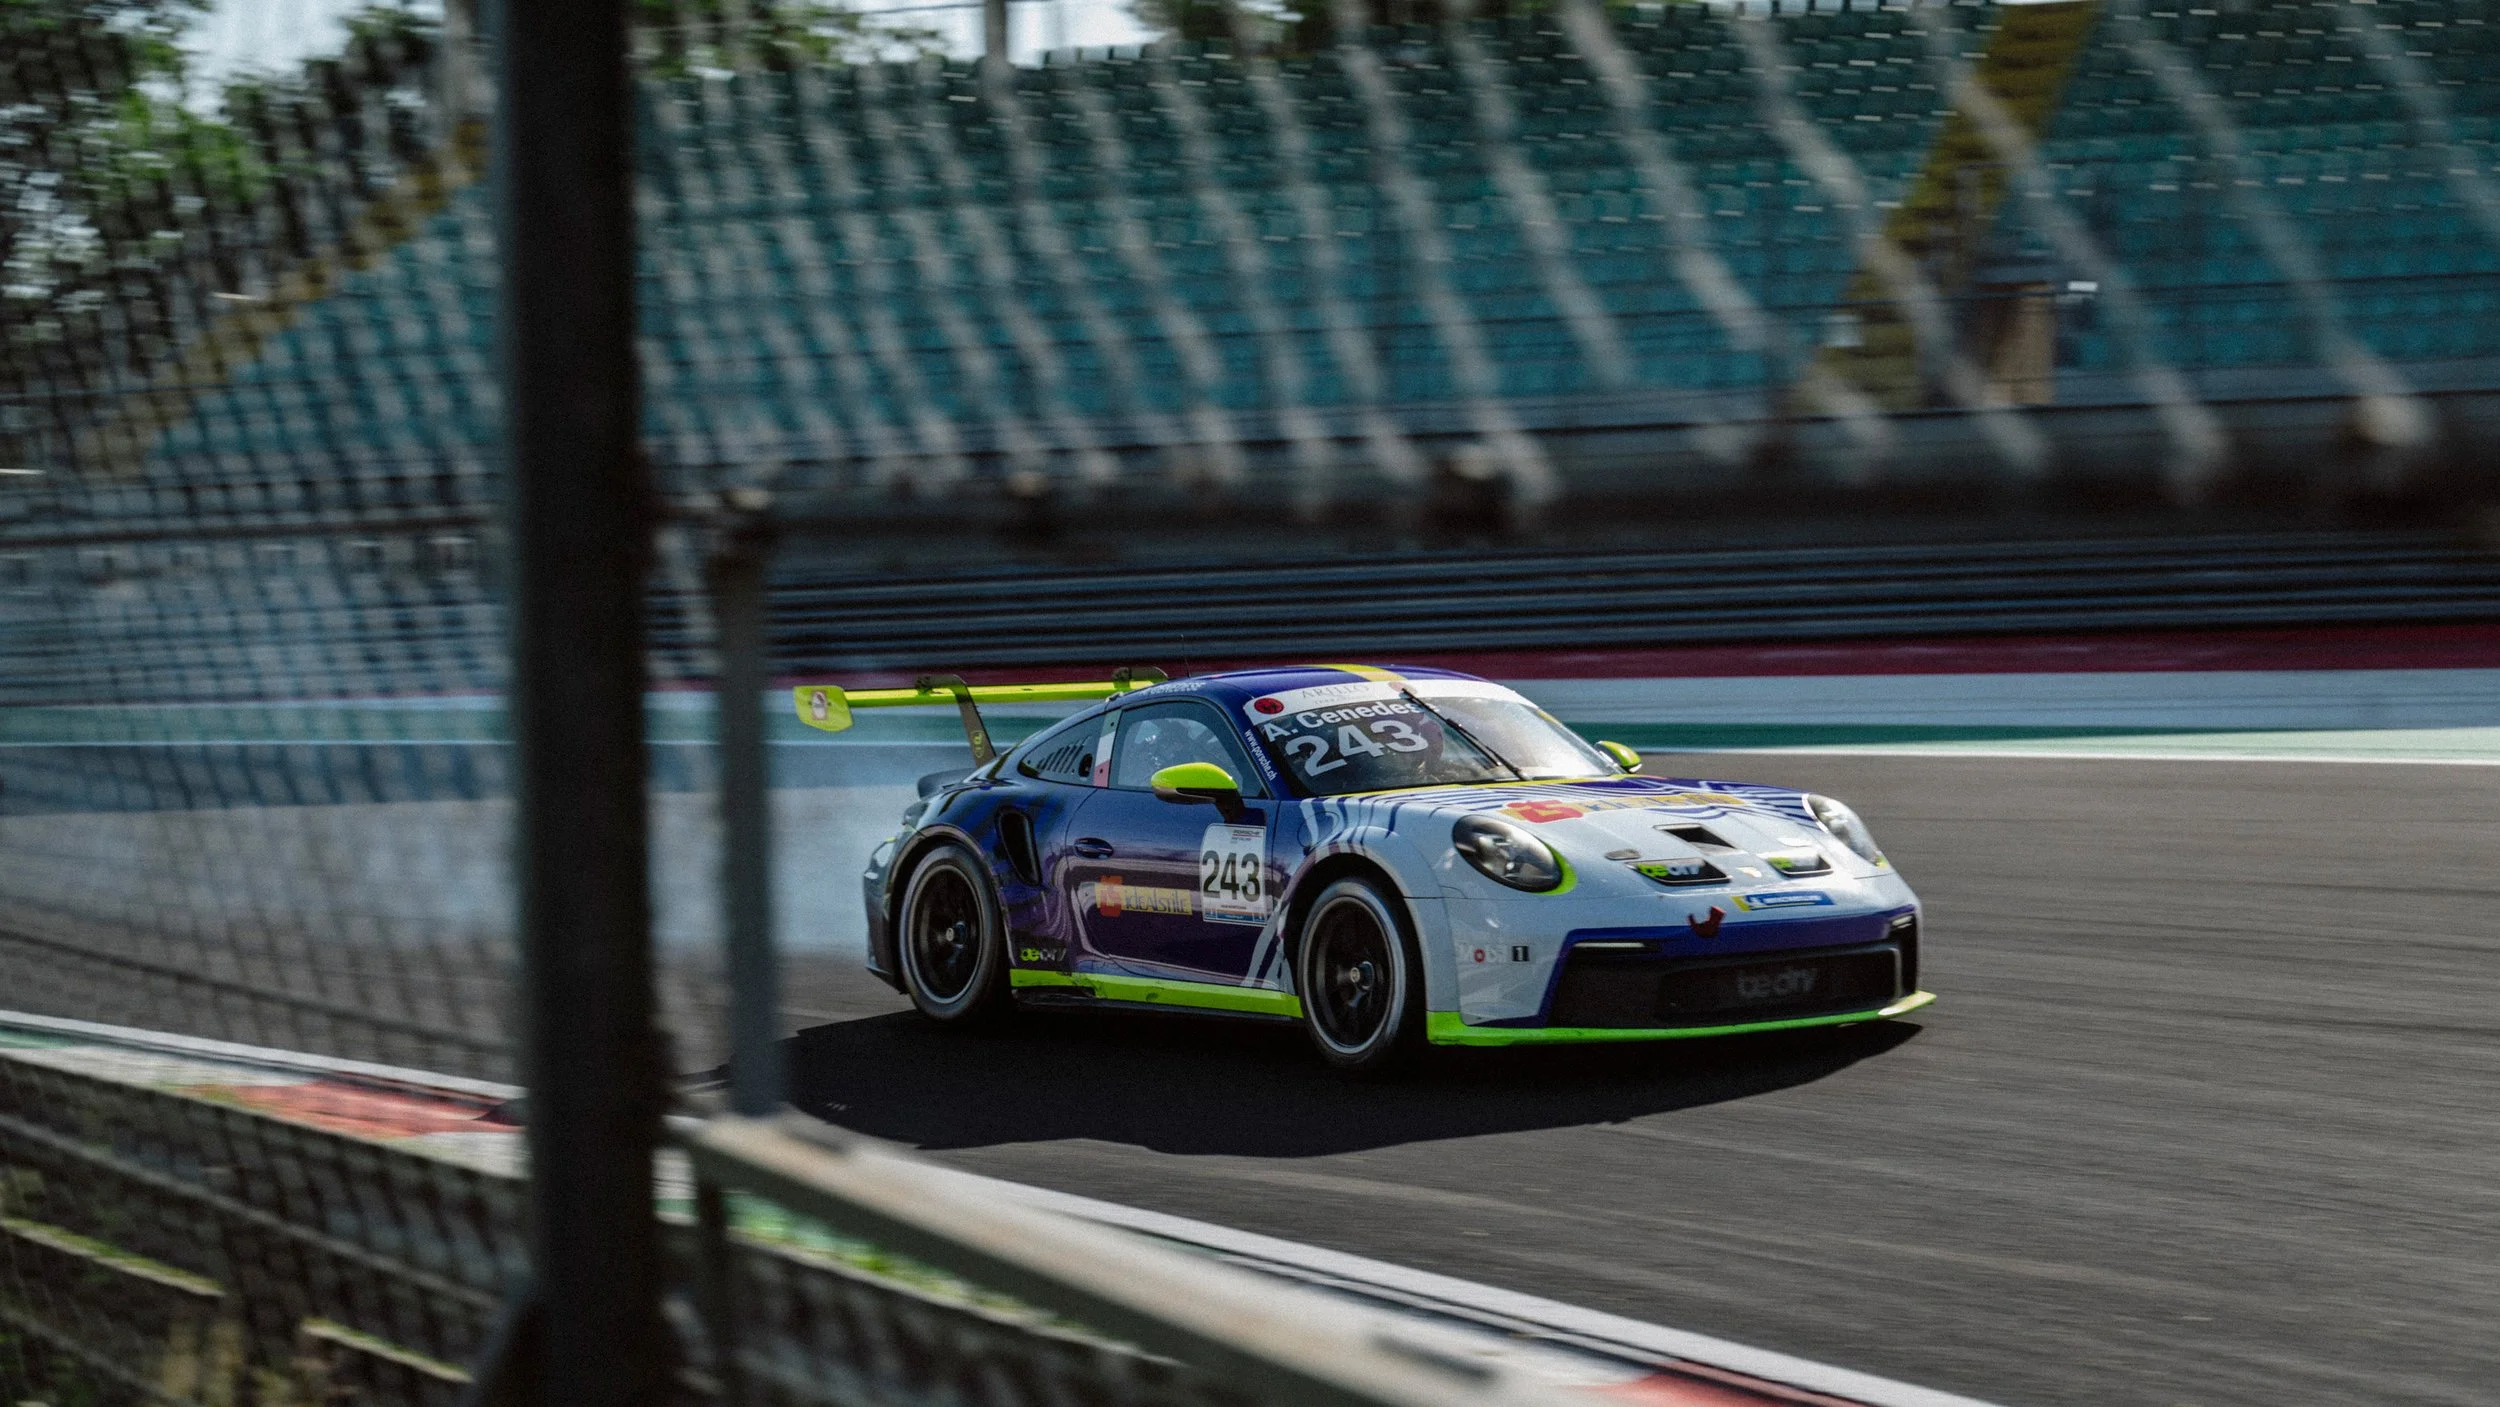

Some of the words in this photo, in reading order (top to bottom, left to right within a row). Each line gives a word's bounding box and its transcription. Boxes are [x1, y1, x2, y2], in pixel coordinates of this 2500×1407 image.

[1245, 729, 1278, 781] www.porsche.ch
[1261, 722, 1299, 743] A.
[1285, 719, 1429, 777] 243
[1202, 850, 1260, 902] 243
[1514, 946, 1526, 961] 1
